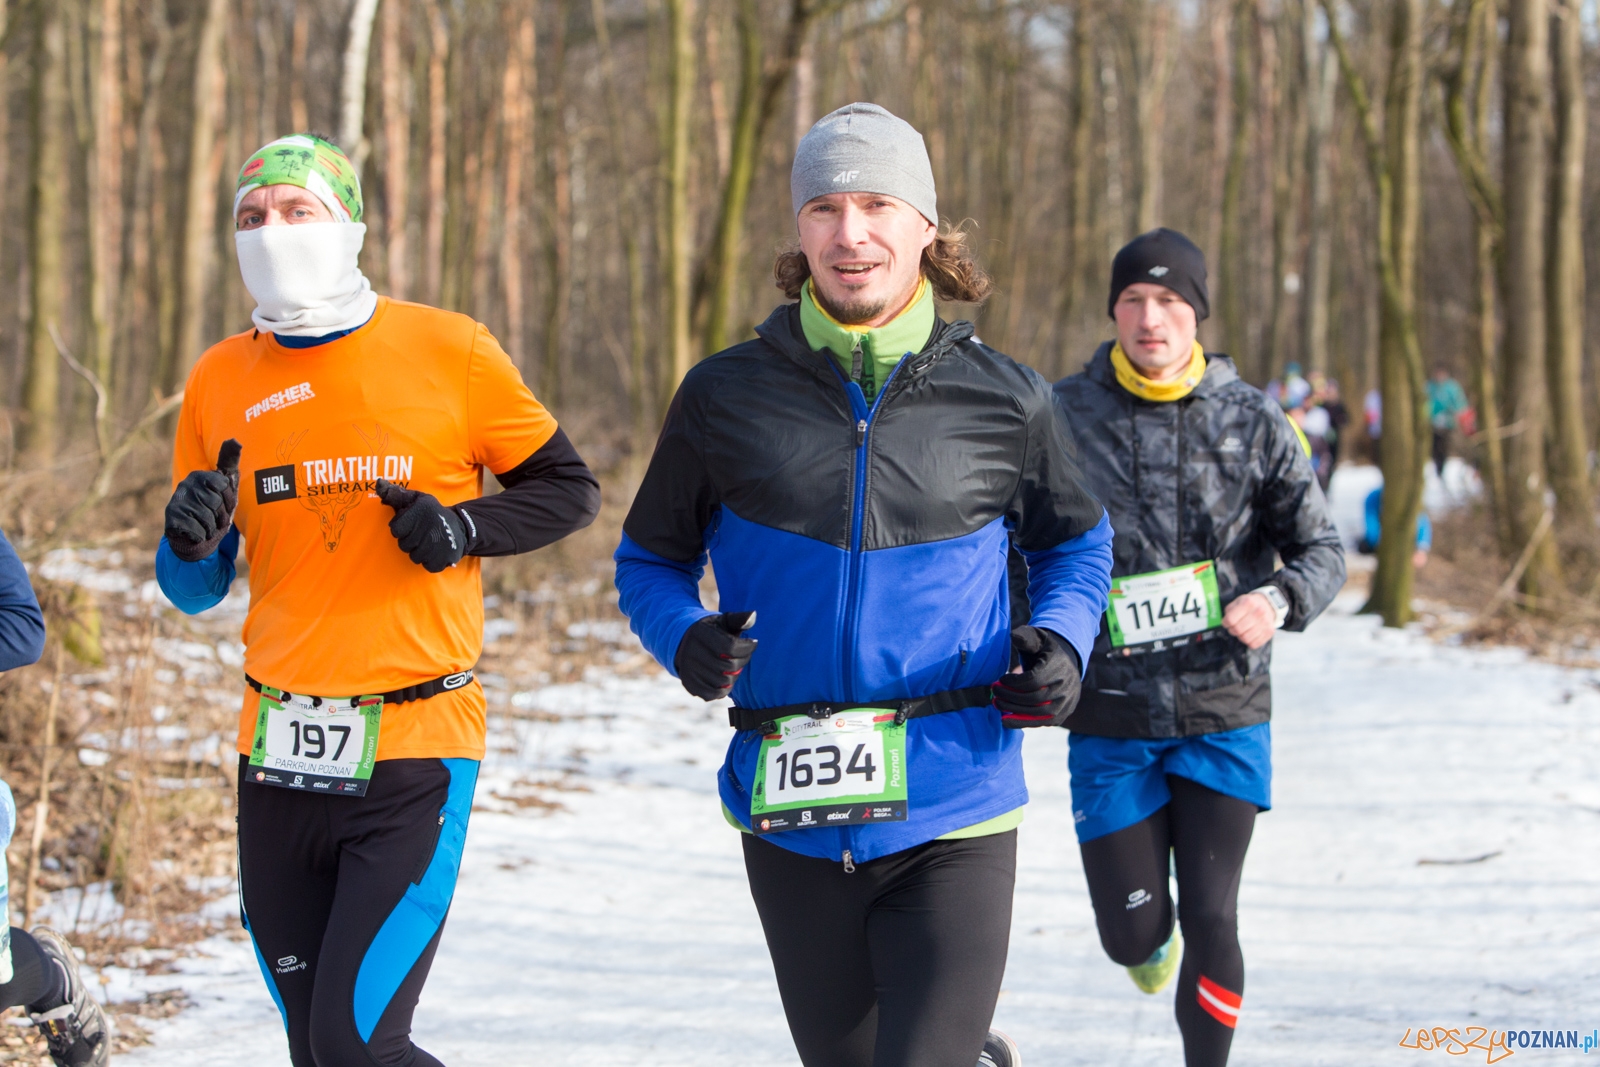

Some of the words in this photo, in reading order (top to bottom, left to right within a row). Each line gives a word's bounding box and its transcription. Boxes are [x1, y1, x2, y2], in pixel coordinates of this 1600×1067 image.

[832, 170, 860, 184] 4F
[245, 381, 314, 423] FINISHER
[262, 475, 290, 495] JBL
[302, 455, 413, 487] TRIATHLON
[307, 480, 410, 497] SIERAKW
[1126, 591, 1202, 631] 1144
[289, 720, 352, 762] 197
[363, 736, 376, 769] Poznań
[274, 757, 318, 773] PARKRUN
[775, 743, 877, 791] 1634
[890, 747, 900, 788] Poznań
[275, 960, 307, 974] Kalenji
